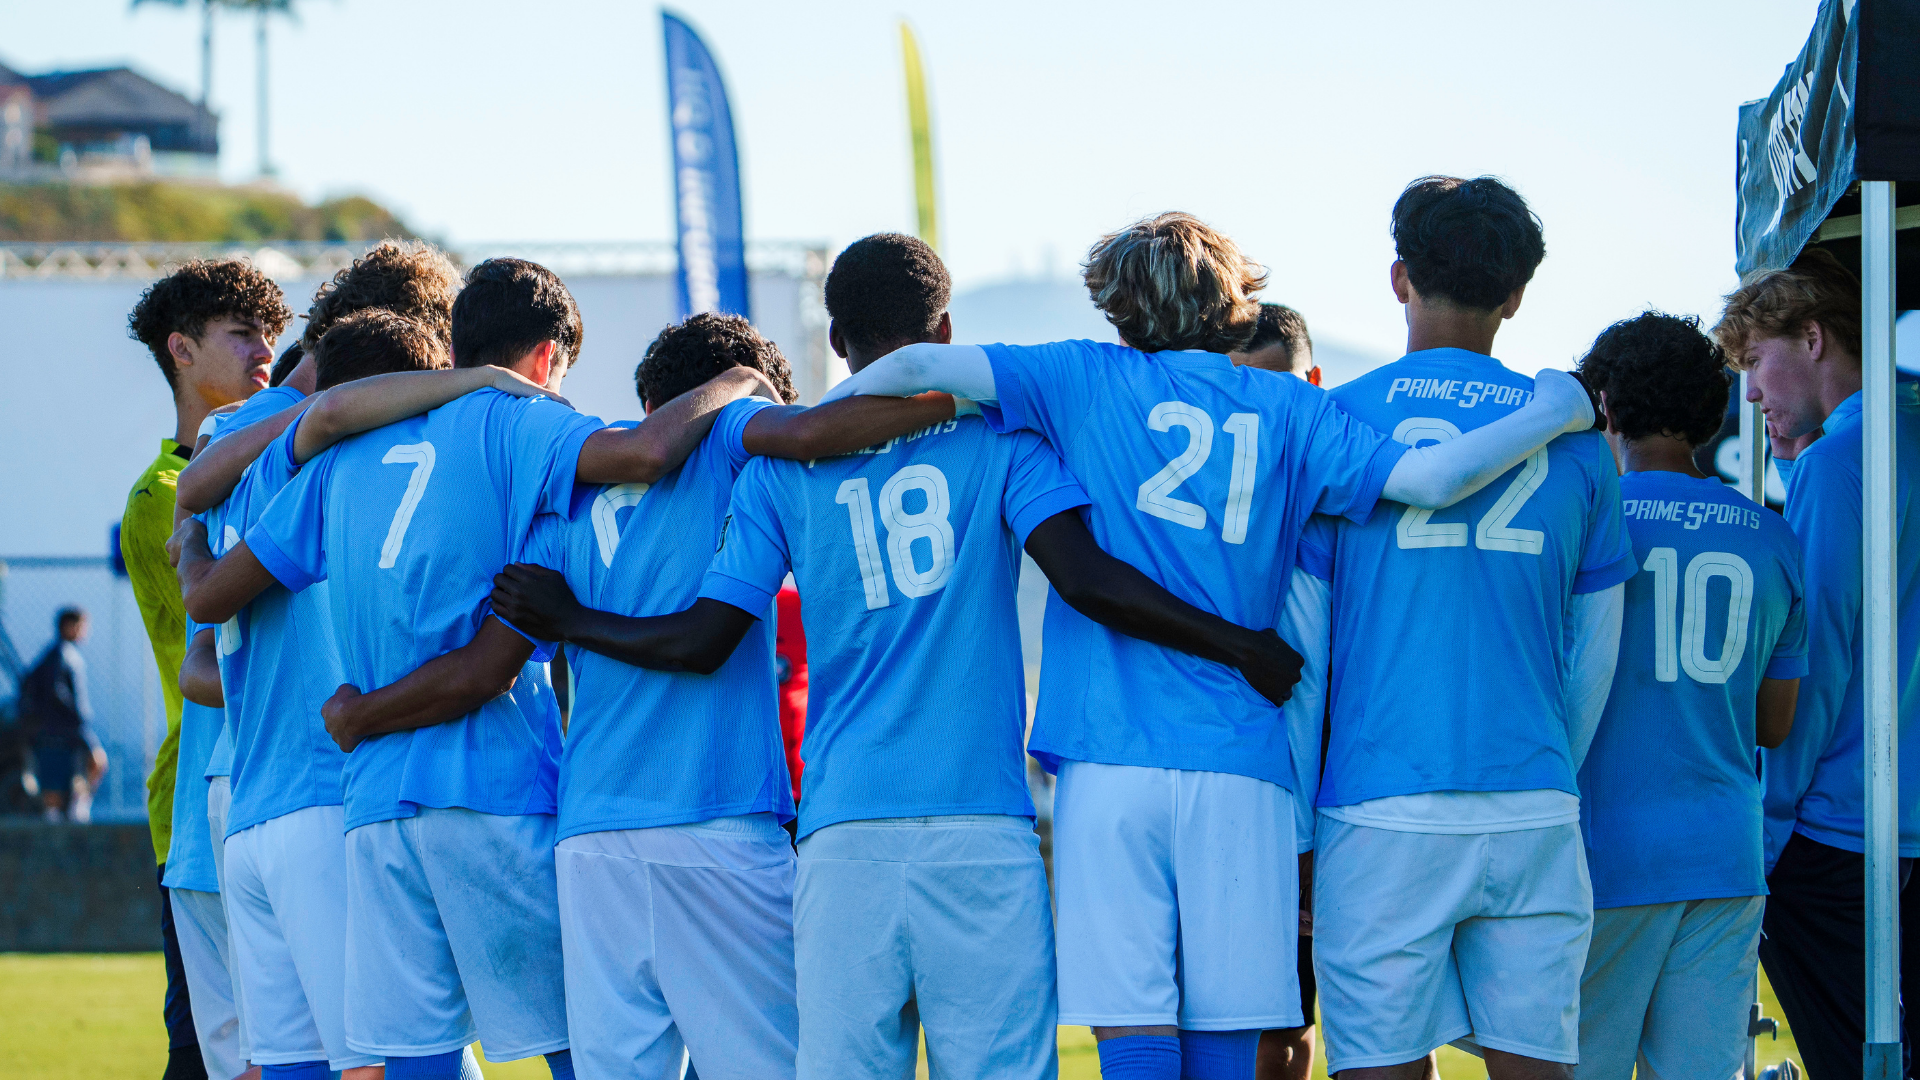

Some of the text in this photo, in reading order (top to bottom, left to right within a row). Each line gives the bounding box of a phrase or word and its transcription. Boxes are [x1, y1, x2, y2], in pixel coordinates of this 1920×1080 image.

[1386, 377, 1534, 408] PRIMESPORT
[378, 441, 436, 569] 7
[835, 463, 956, 610] 18
[1136, 401, 1260, 545] 21
[1643, 547, 1754, 684] 10
